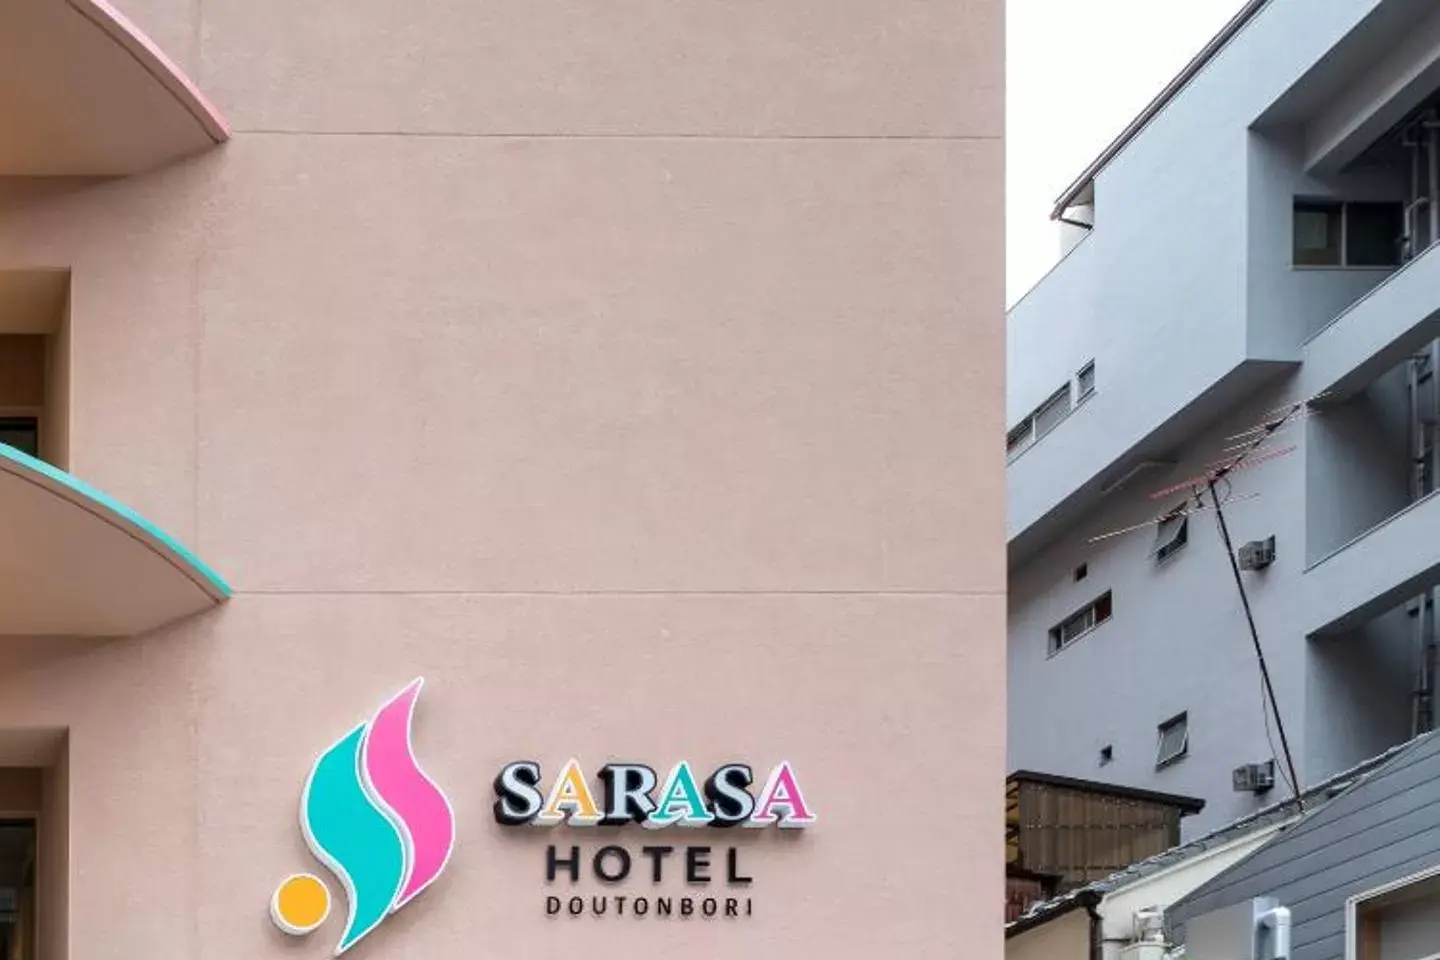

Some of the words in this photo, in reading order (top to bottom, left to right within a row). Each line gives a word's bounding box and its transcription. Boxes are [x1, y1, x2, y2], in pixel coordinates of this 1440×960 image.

[494, 758, 816, 828] SARASA
[546, 844, 753, 884] HOTEL
[545, 896, 753, 917] DOUTONBORI
